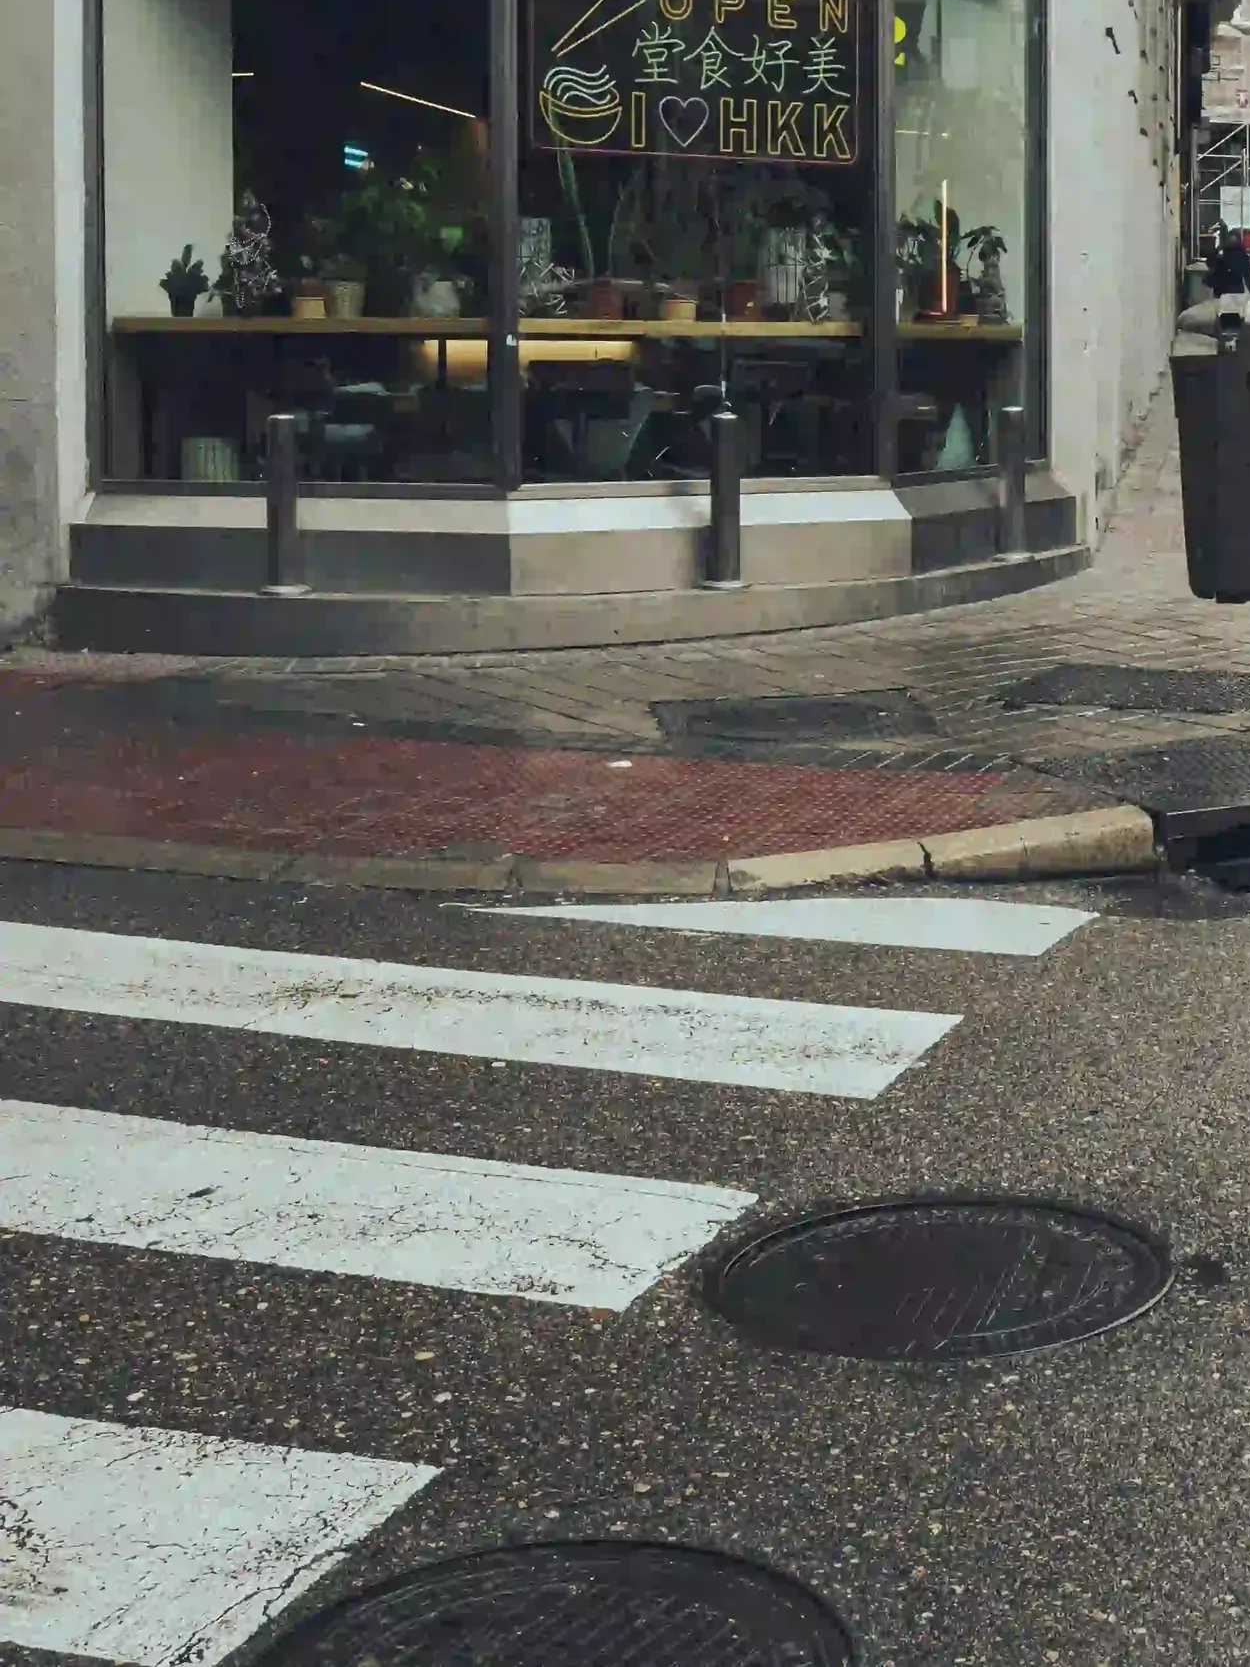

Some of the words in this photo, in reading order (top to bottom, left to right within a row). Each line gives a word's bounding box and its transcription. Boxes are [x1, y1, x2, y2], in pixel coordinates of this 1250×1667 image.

[632, 21, 851, 97] 堂食好美
[719, 96, 851, 159] HKK
